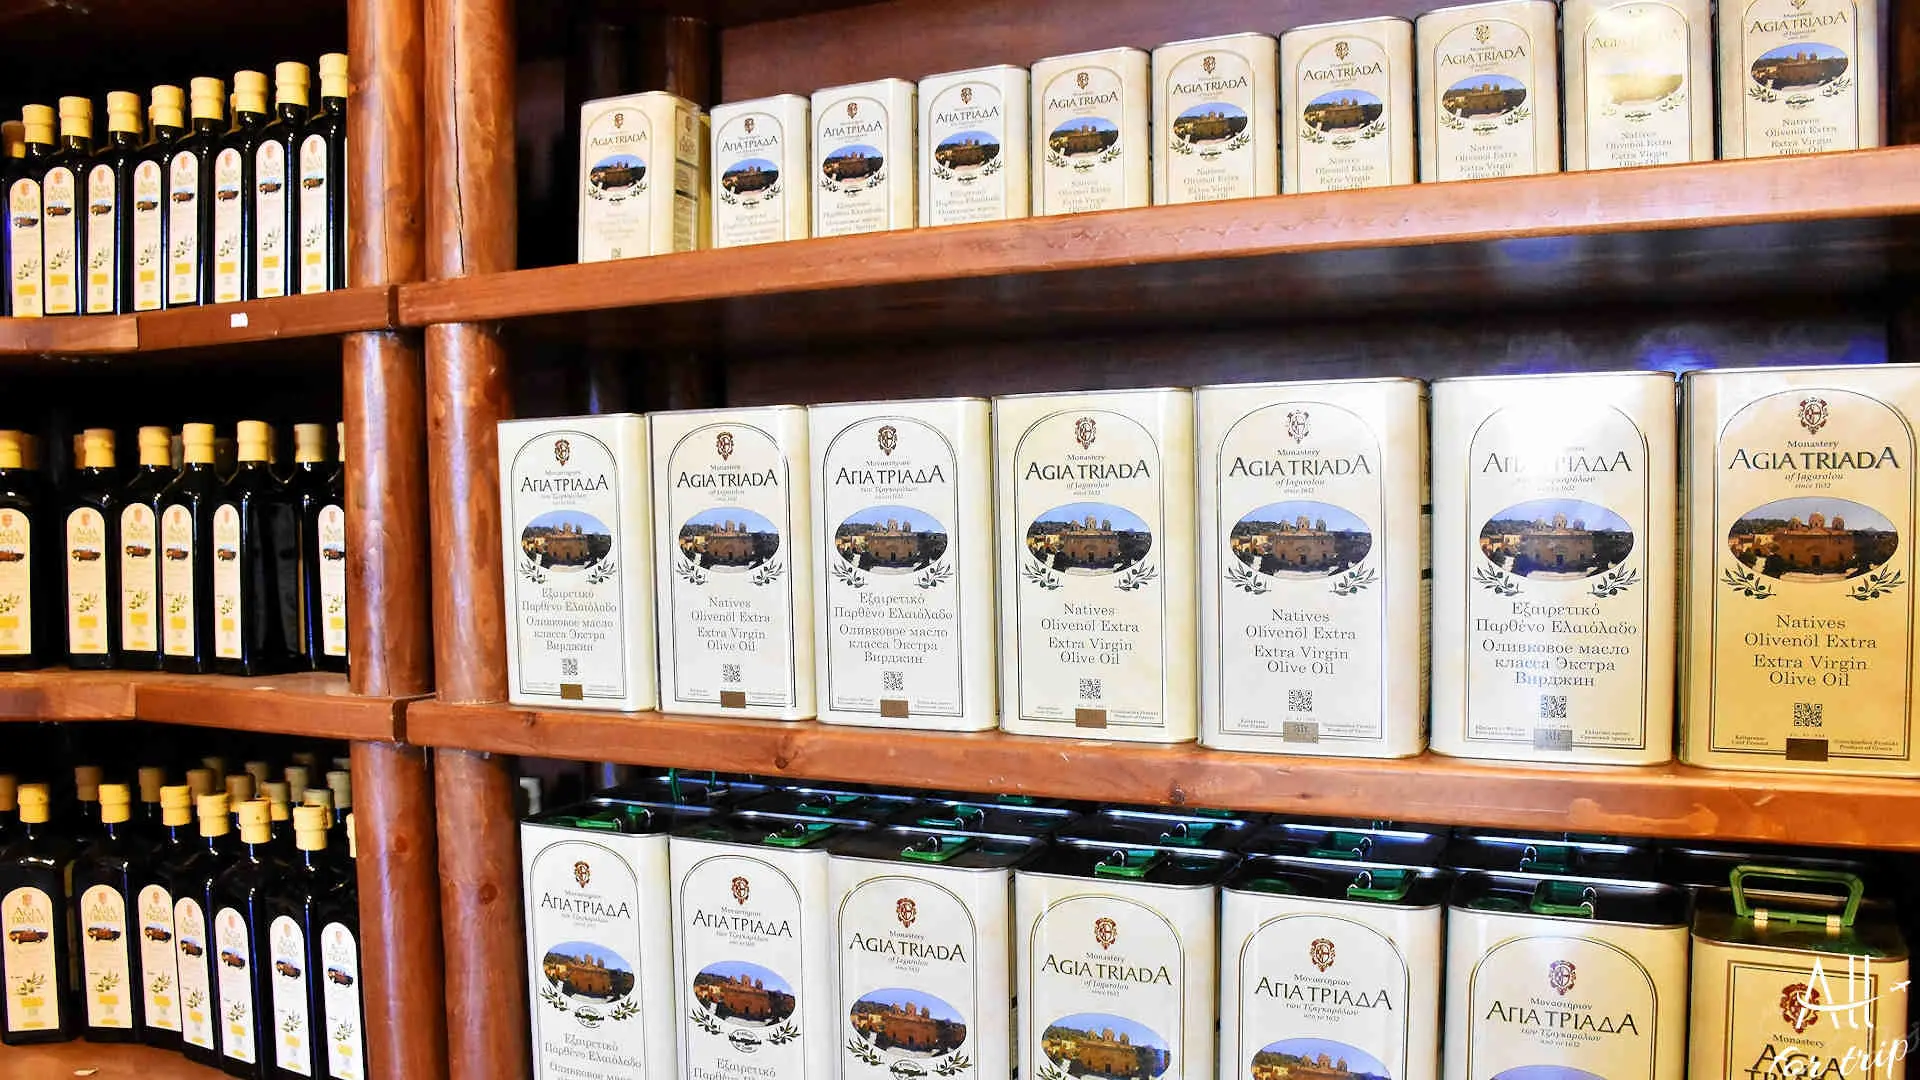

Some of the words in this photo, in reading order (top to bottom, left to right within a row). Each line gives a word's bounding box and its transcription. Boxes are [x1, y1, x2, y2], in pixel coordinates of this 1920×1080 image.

[1749, 20, 1788, 34] AGIA
[1790, 11, 1848, 29] TRIADA
[1441, 52, 1476, 66] AGIA
[1476, 45, 1526, 63] TRIADA
[1303, 70, 1335, 81] AGIA
[1337, 62, 1383, 78] TRIADA
[1173, 83, 1202, 95] AGIA
[1203, 76, 1248, 91] TRIADA
[1048, 97, 1079, 110] AGIA
[1078, 91, 1118, 106] TRIADA
[1787, 440, 1839, 449] Monastery
[1229, 456, 1285, 477] AGIA
[1288, 454, 1371, 476] TRIADA
[1728, 448, 1797, 470] AGIA
[1800, 446, 1900, 469] TRIADA
[677, 471, 717, 488] AGIA
[718, 468, 778, 487] TRIADA
[835, 466, 875, 485] ΑΓΙΑ
[877, 464, 945, 484] ΤΡΙΑΔΑ
[1025, 461, 1074, 480] AGIA
[1077, 459, 1150, 479] TRIADA
[521, 476, 553, 493] ΑΓΙΑ
[554, 474, 609, 491] ΤΡΙΑΔΑ
[709, 597, 751, 608] Natives
[860, 592, 925, 606] Εξαιρετικό
[740, 611, 770, 622] Extra
[1064, 603, 1115, 616] Natives
[1272, 608, 1330, 622] Natives
[1512, 601, 1600, 618] Εξαιρετικό
[1101, 620, 1140, 633] Extra
[1476, 618, 1545, 634] Παρθένο
[1552, 619, 1637, 635] Ελαιόλαδο
[1776, 614, 1846, 629] Natives
[698, 626, 727, 638] Extra
[730, 627, 766, 640] Virgin
[1246, 624, 1308, 639] Olivenöl
[1313, 626, 1356, 640] Extra
[1744, 631, 1818, 647] Olivenöl
[1827, 633, 1877, 648] Extra
[707, 639, 735, 651] Olive
[739, 640, 755, 652] Oil
[1049, 636, 1085, 649] Extra
[1089, 638, 1133, 652] Virgin
[1255, 644, 1295, 658] Extra
[1300, 645, 1348, 661] Virgin
[1482, 638, 1573, 654] Оливковое
[1579, 645, 1630, 656] масло
[1060, 650, 1095, 663] Olive
[1099, 651, 1120, 665] Oil
[1495, 657, 1549, 669] класса
[1556, 656, 1616, 673] Экстра
[1754, 654, 1802, 668] Extra
[1810, 655, 1867, 672] Virgin
[1267, 660, 1307, 674] Olive
[1311, 661, 1334, 675] Oil
[1516, 671, 1594, 687] Вирджин
[1769, 671, 1816, 686] Olive
[1823, 672, 1849, 687] Oil
[541, 892, 572, 912] ΑΓΙΑ
[574, 899, 630, 919] ΤΡΙΑΔΑ
[693, 909, 729, 930] ΑΓΙΑ
[731, 916, 792, 938] ΤΡΙΑΔΑ
[849, 932, 896, 954] AGIA
[898, 940, 967, 963] TRIADA
[1086, 952, 1125, 962] Monastery
[1041, 953, 1093, 977] AGIA
[1096, 963, 1172, 986] TRIADA
[1254, 976, 1304, 1000] ΑΓΙΑ
[1307, 986, 1392, 1010] ΤΡΙΑΔΑ
[1486, 1000, 1541, 1025] ΑΓΙΑ
[1545, 1010, 1639, 1036] ΤΡΙΑΔΑ
[1772, 1033, 1825, 1048] Monastery
